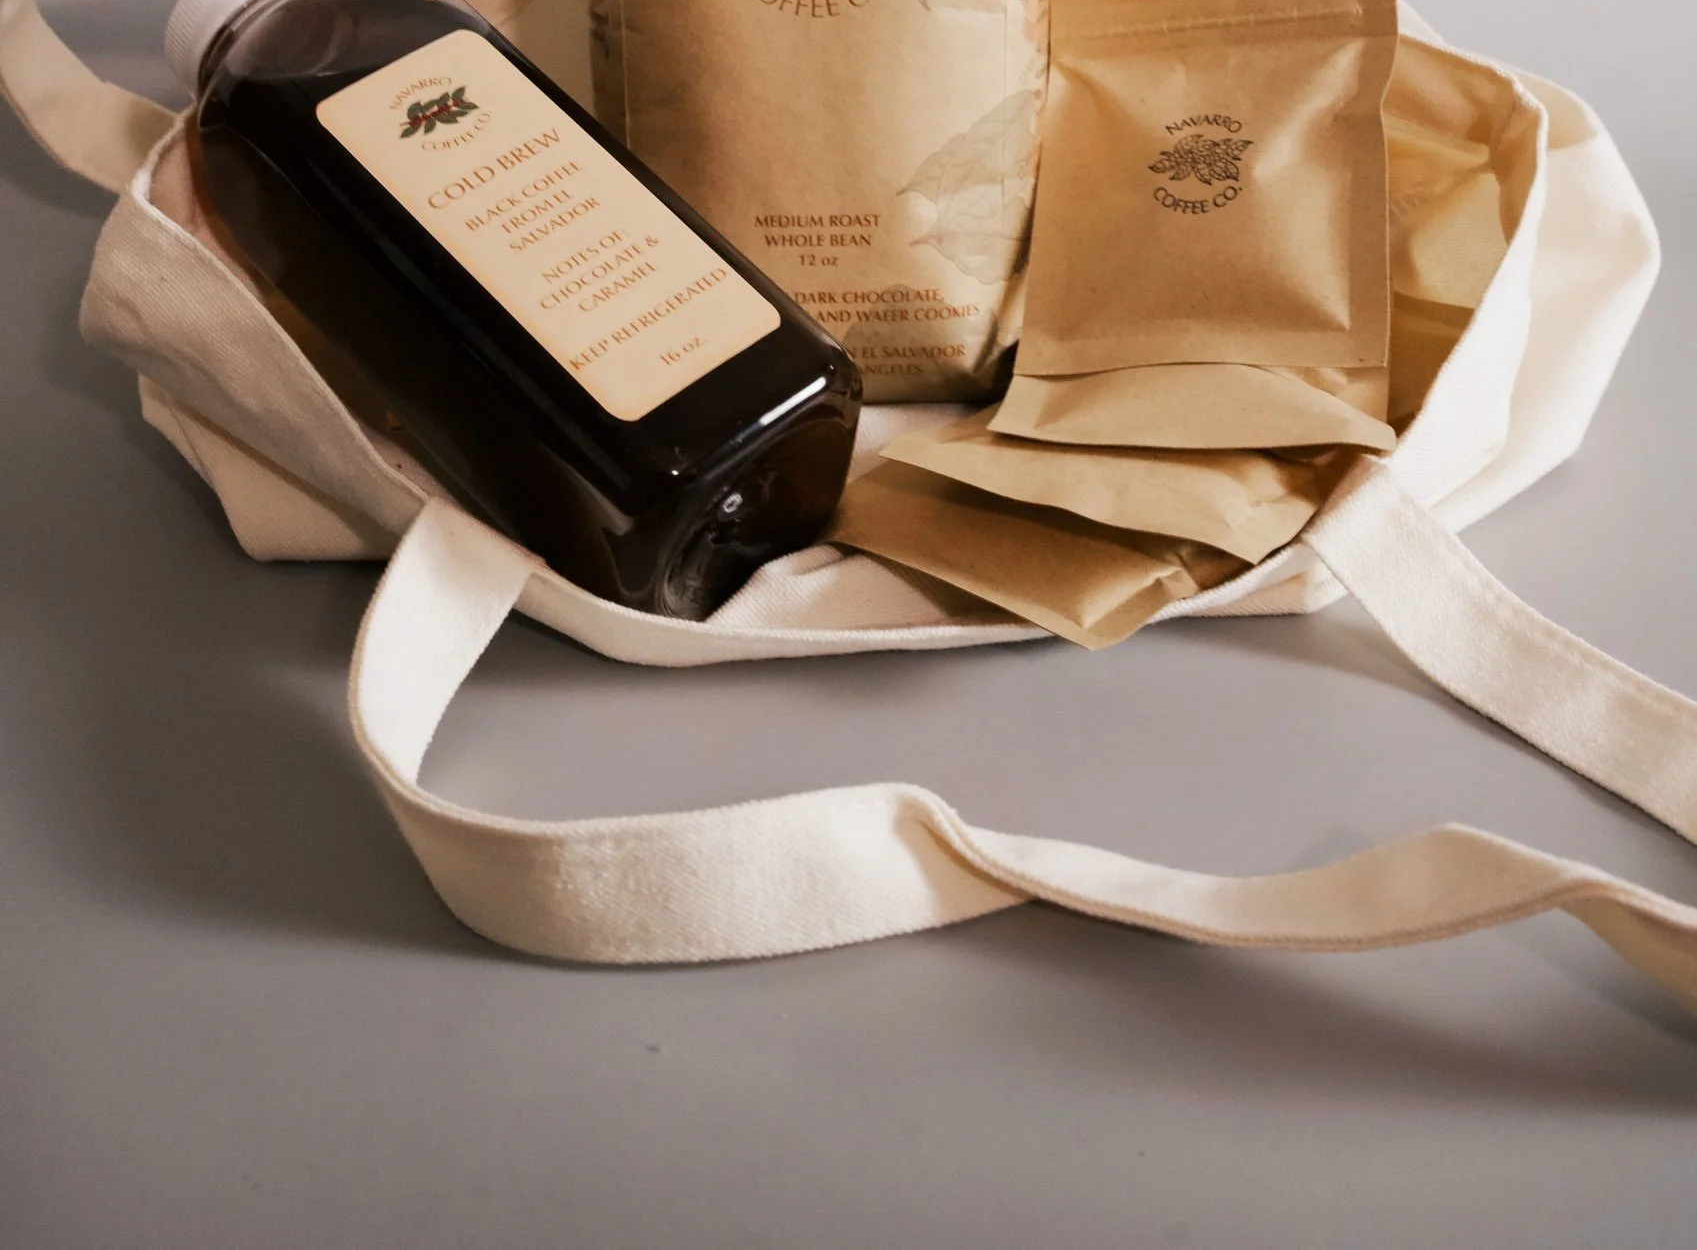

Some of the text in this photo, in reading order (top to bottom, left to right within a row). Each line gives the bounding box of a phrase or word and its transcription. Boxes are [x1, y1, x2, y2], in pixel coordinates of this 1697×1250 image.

[389, 76, 452, 110] NAVARRO
[1165, 114, 1242, 135] NAVARRO
[428, 128, 561, 210] COLD BREW
[464, 160, 583, 232] BLACK COFFEE
[1153, 186, 1243, 214] COFFEE CO.
[501, 190, 573, 234] FROM EL
[509, 197, 602, 253] SALVADOR
[754, 214, 880, 228] MEDIUM ROAST
[764, 234, 872, 247] WHOLE BEAN
[540, 236, 660, 310] CHOCOLATE &
[541, 246, 600, 285] NOTES
[799, 254, 839, 267] 12 oz
[578, 261, 659, 312] CARAMEL
[794, 292, 838, 304] DARK
[569, 268, 728, 371] KEEP REFRIGERATED
[816, 303, 980, 323] AND WAFER COOKIES
[660, 350, 681, 366] 16
[862, 347, 878, 359] EL
[882, 344, 966, 359] SALVADOR
